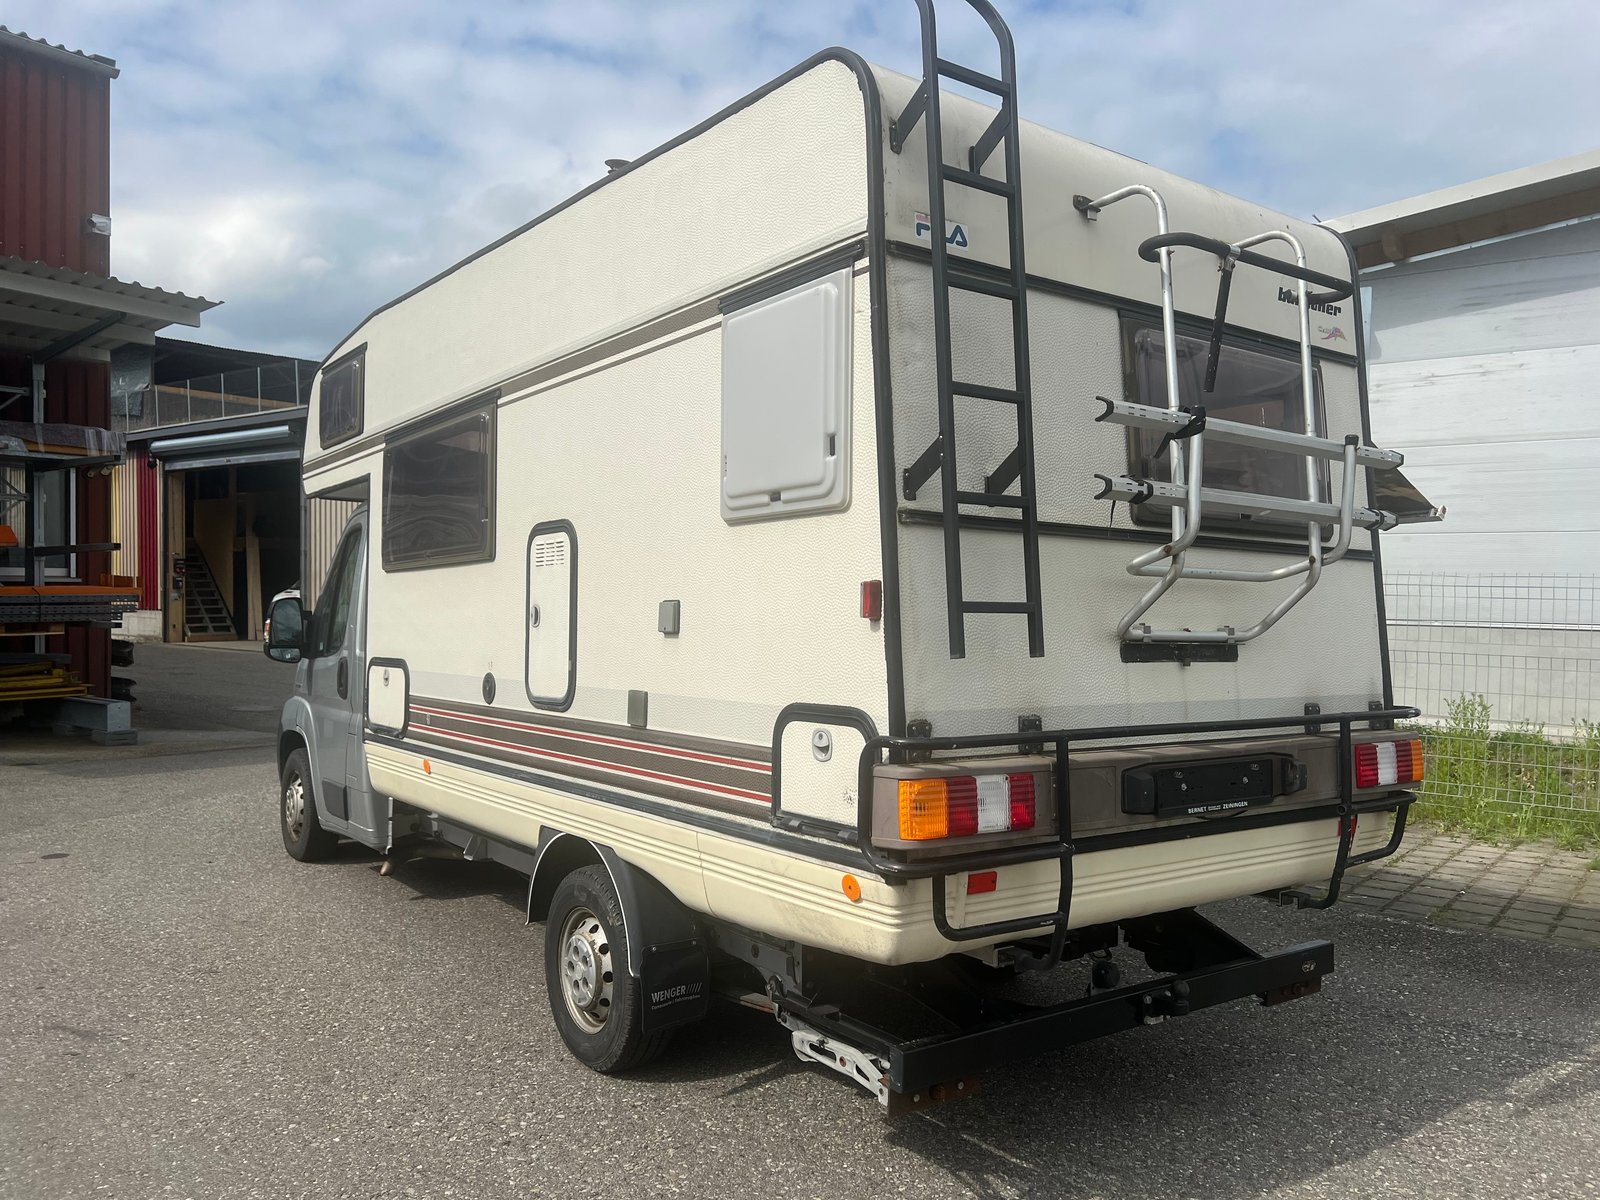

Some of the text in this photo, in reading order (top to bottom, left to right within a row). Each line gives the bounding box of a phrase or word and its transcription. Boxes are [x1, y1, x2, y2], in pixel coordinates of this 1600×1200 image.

[1187, 806, 1207, 814] BERNET
[1222, 801, 1249, 810] ZEININGEN
[651, 985, 687, 1003] WENGER
